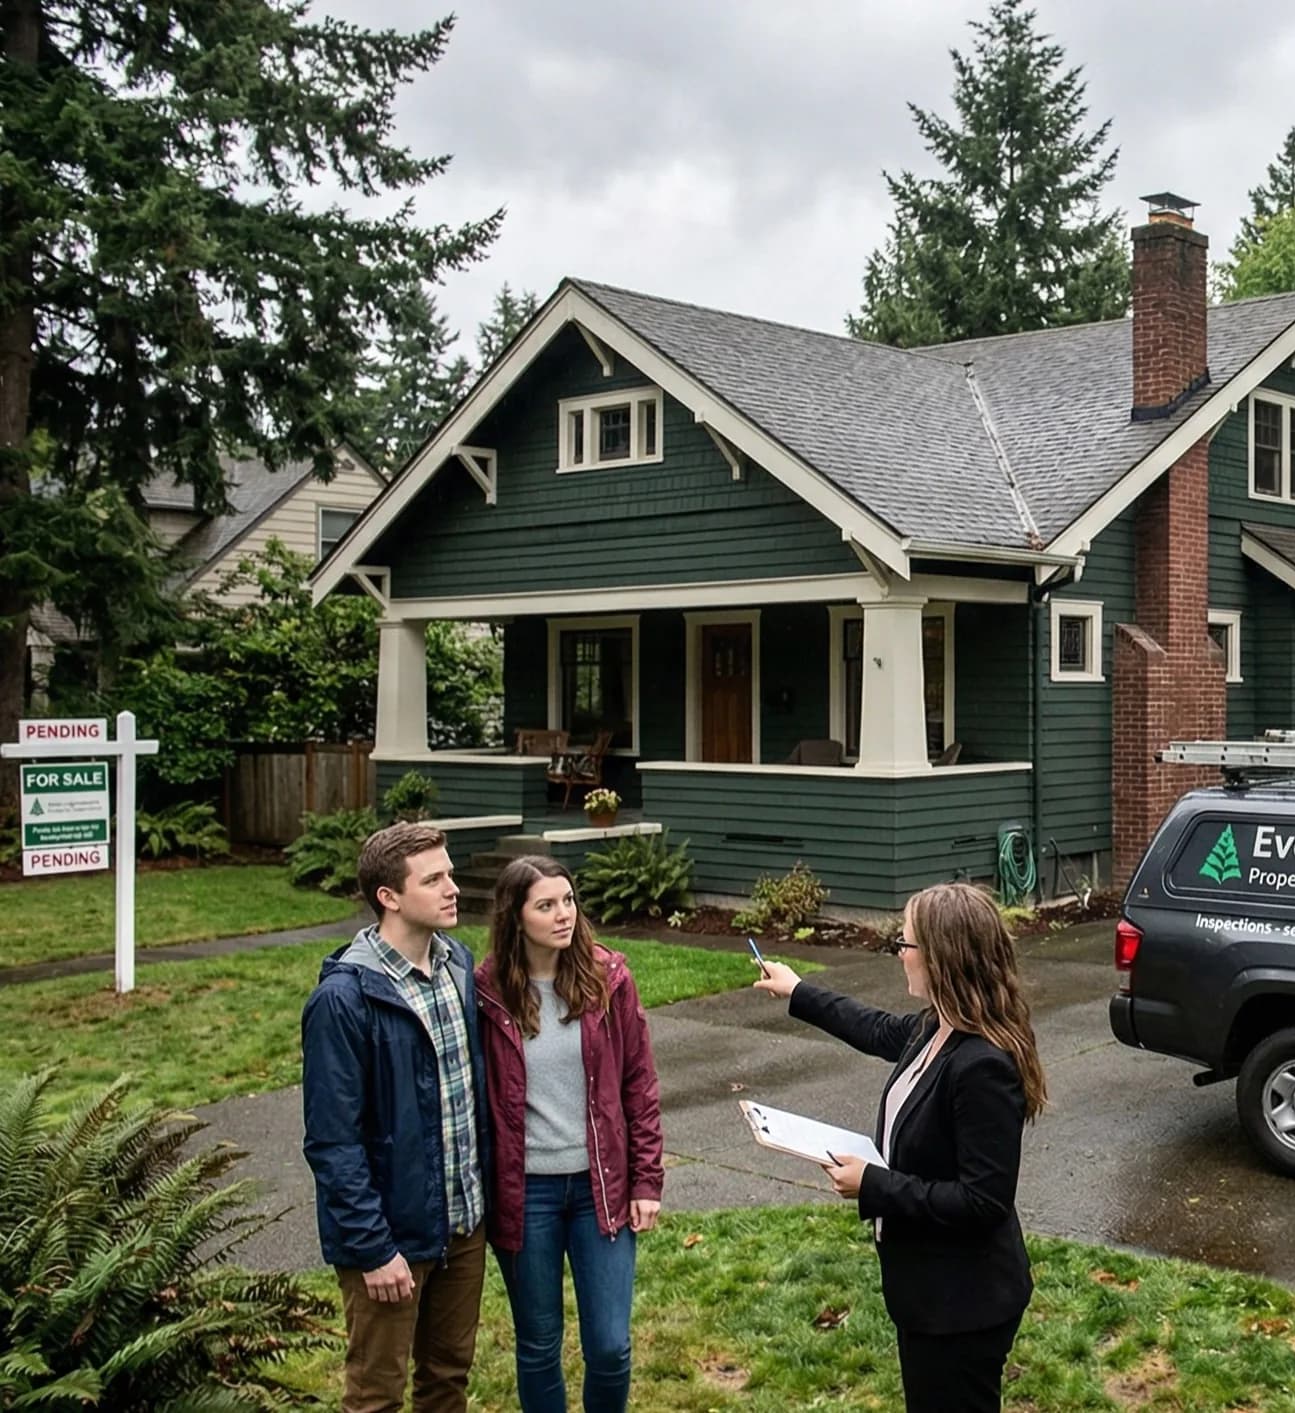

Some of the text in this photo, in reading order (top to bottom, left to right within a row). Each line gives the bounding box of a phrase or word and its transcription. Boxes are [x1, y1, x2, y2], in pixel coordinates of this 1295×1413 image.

[26, 724, 100, 739] PENDING
[26, 772, 103, 788] FOR SALE
[31, 850, 101, 869] PENDING
[1195, 913, 1272, 936] Inspections
